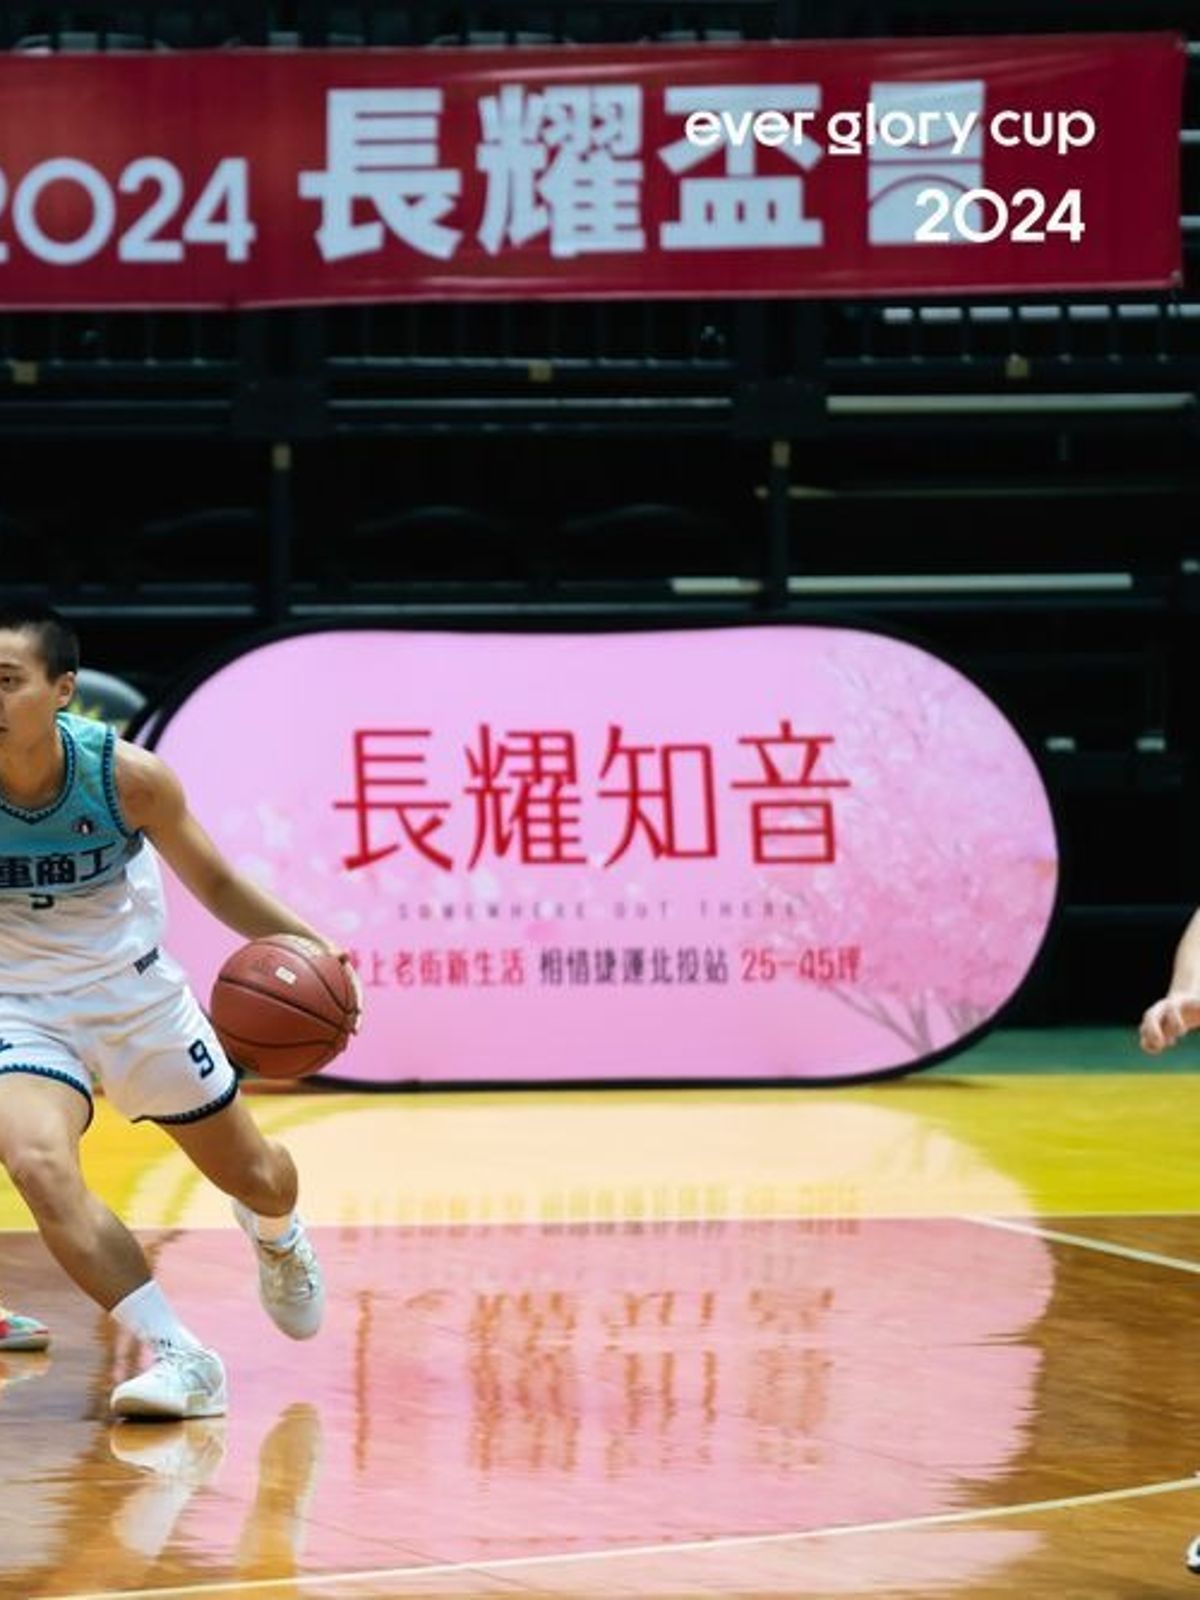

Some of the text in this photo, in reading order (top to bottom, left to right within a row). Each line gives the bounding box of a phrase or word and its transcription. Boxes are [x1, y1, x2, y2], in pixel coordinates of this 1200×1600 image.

[298, 83, 824, 261] 長耀盃
[332, 719, 852, 873] 長耀知音
[188, 1038, 215, 1080] 9
